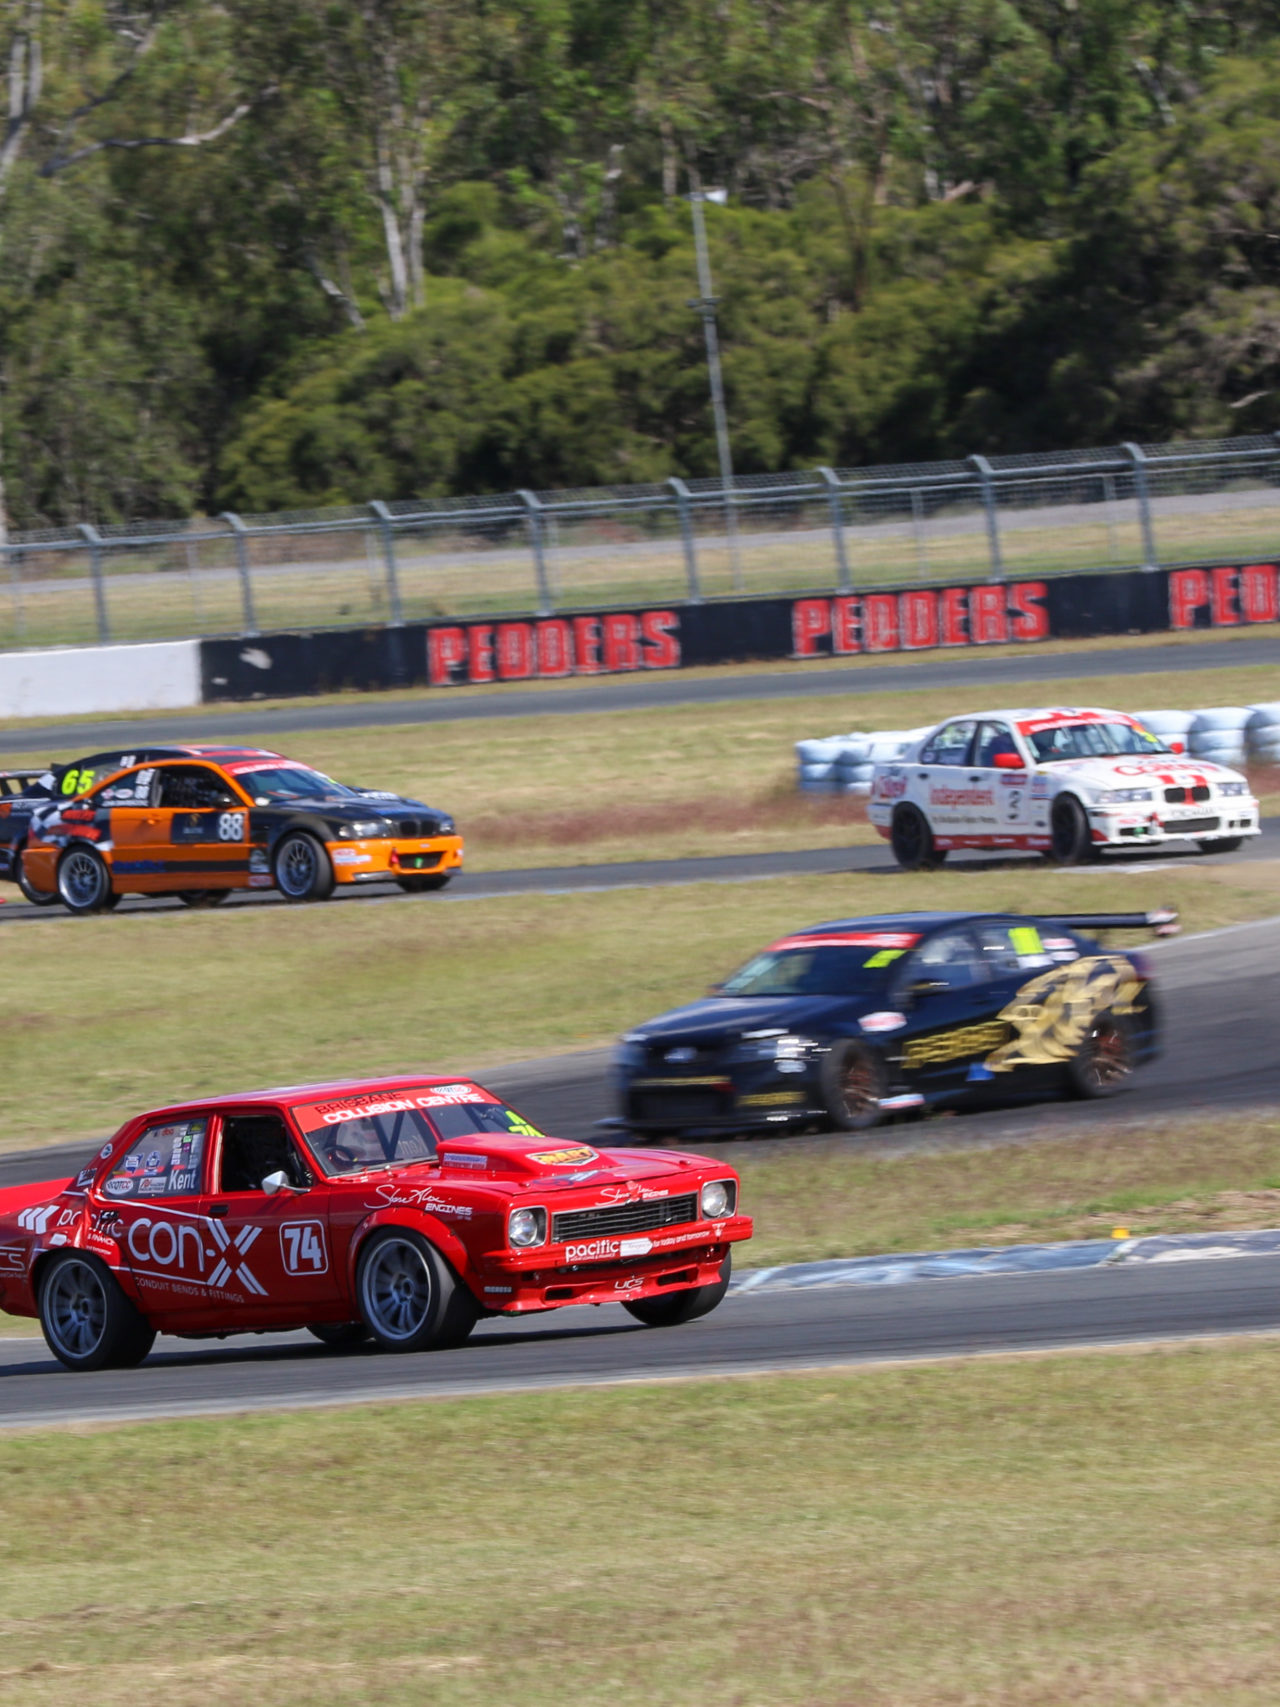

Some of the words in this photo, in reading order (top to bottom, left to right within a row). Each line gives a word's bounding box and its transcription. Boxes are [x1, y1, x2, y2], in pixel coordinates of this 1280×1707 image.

[792, 582, 1049, 656] PEDDERS
[427, 611, 680, 686] PEDDERS
[62, 769, 95, 795] 65
[219, 803, 244, 840] 88
[313, 1091, 406, 1115] BRISBANE
[321, 1098, 416, 1125] COLLISION
[416, 1092, 486, 1108] CENTRE
[168, 1169, 197, 1190] Kent
[424, 1203, 473, 1216] ENGINES
[284, 1226, 323, 1271] 74
[565, 1239, 620, 1263] pacific
[135, 1276, 170, 1292] CONDUIT
[171, 1282, 199, 1297] BENDS
[200, 1286, 207, 1297] &
[209, 1288, 245, 1304] FITTINGS
